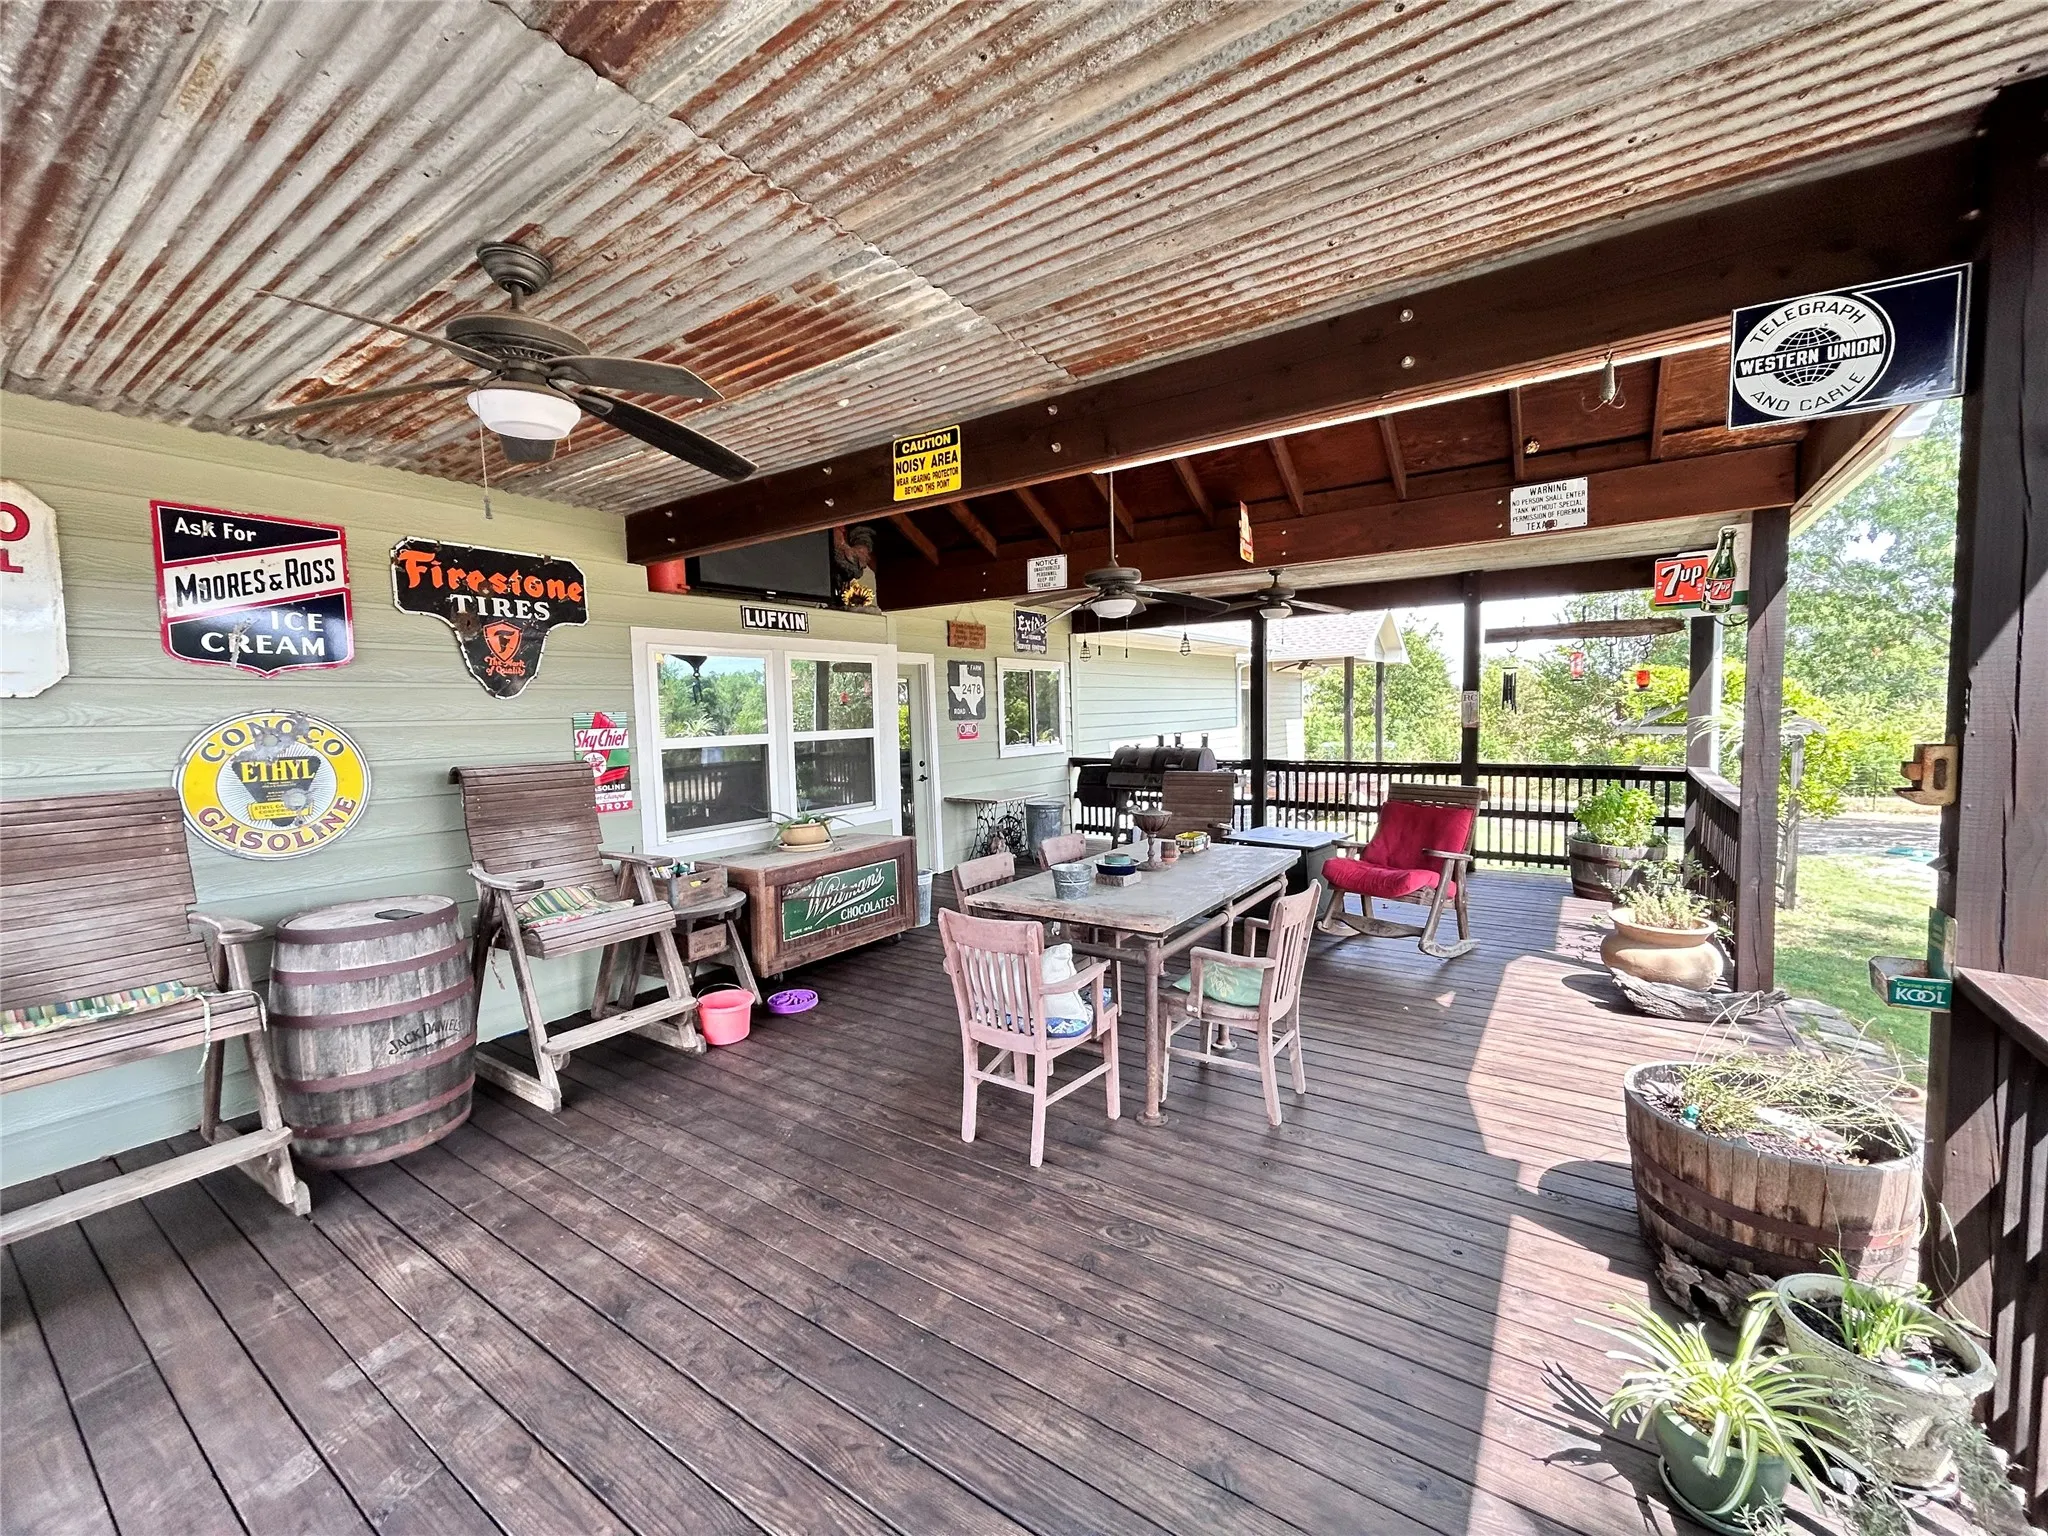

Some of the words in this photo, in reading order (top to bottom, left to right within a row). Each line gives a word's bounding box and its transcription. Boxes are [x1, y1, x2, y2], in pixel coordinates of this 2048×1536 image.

[1750, 300, 1866, 344] TELEGRAPH
[1740, 348, 1819, 376] WESTERN
[1827, 336, 1880, 361] UNION
[1750, 391, 1790, 411] AND
[902, 433, 951, 454] CAUTION
[896, 457, 926, 475] NOISY
[931, 449, 958, 468] AREA
[896, 477, 909, 486] WEAR
[911, 473, 930, 483] HEARING
[904, 484, 923, 495] BEYOND
[925, 482, 935, 491] THIS
[937, 479, 950, 489] POINT
[1530, 483, 1567, 496] WARNING
[1521, 497, 1543, 505] PERSON
[1566, 490, 1585, 499] ENTER
[1531, 503, 1556, 512] WITHOUT
[1558, 499, 1582, 508] SPECIAL
[1512, 512, 1546, 522] PERMISSION
[1557, 507, 1585, 516] FOREMAN
[1527, 519, 1558, 530] TEXAO
[174, 517, 216, 538] Ask
[223, 523, 257, 541] For
[1035, 558, 1058, 567] NOTICE
[175, 568, 266, 607] MOORES
[285, 558, 336, 588] ROSS
[398, 549, 584, 602] Firestone
[1661, 564, 1703, 596] 7up
[1714, 582, 1730, 596] 7up
[450, 593, 551, 621] TIRES
[271, 610, 324, 632] ICE
[745, 608, 806, 631] LUFKIN
[201, 632, 326, 656] CREAM
[962, 684, 981, 694] 2478
[201, 719, 345, 762] CONOCO
[576, 729, 597, 750] Sky
[598, 728, 628, 747] Chief
[240, 759, 316, 783] ETHYL
[595, 783, 626, 792] SOLINE
[599, 801, 629, 812] TROX
[199, 797, 357, 851] GASOLINE
[840, 895, 895, 920] CHOCOLATES
[1895, 987, 1946, 1004] KOOL
[388, 1028, 422, 1055] JACK
